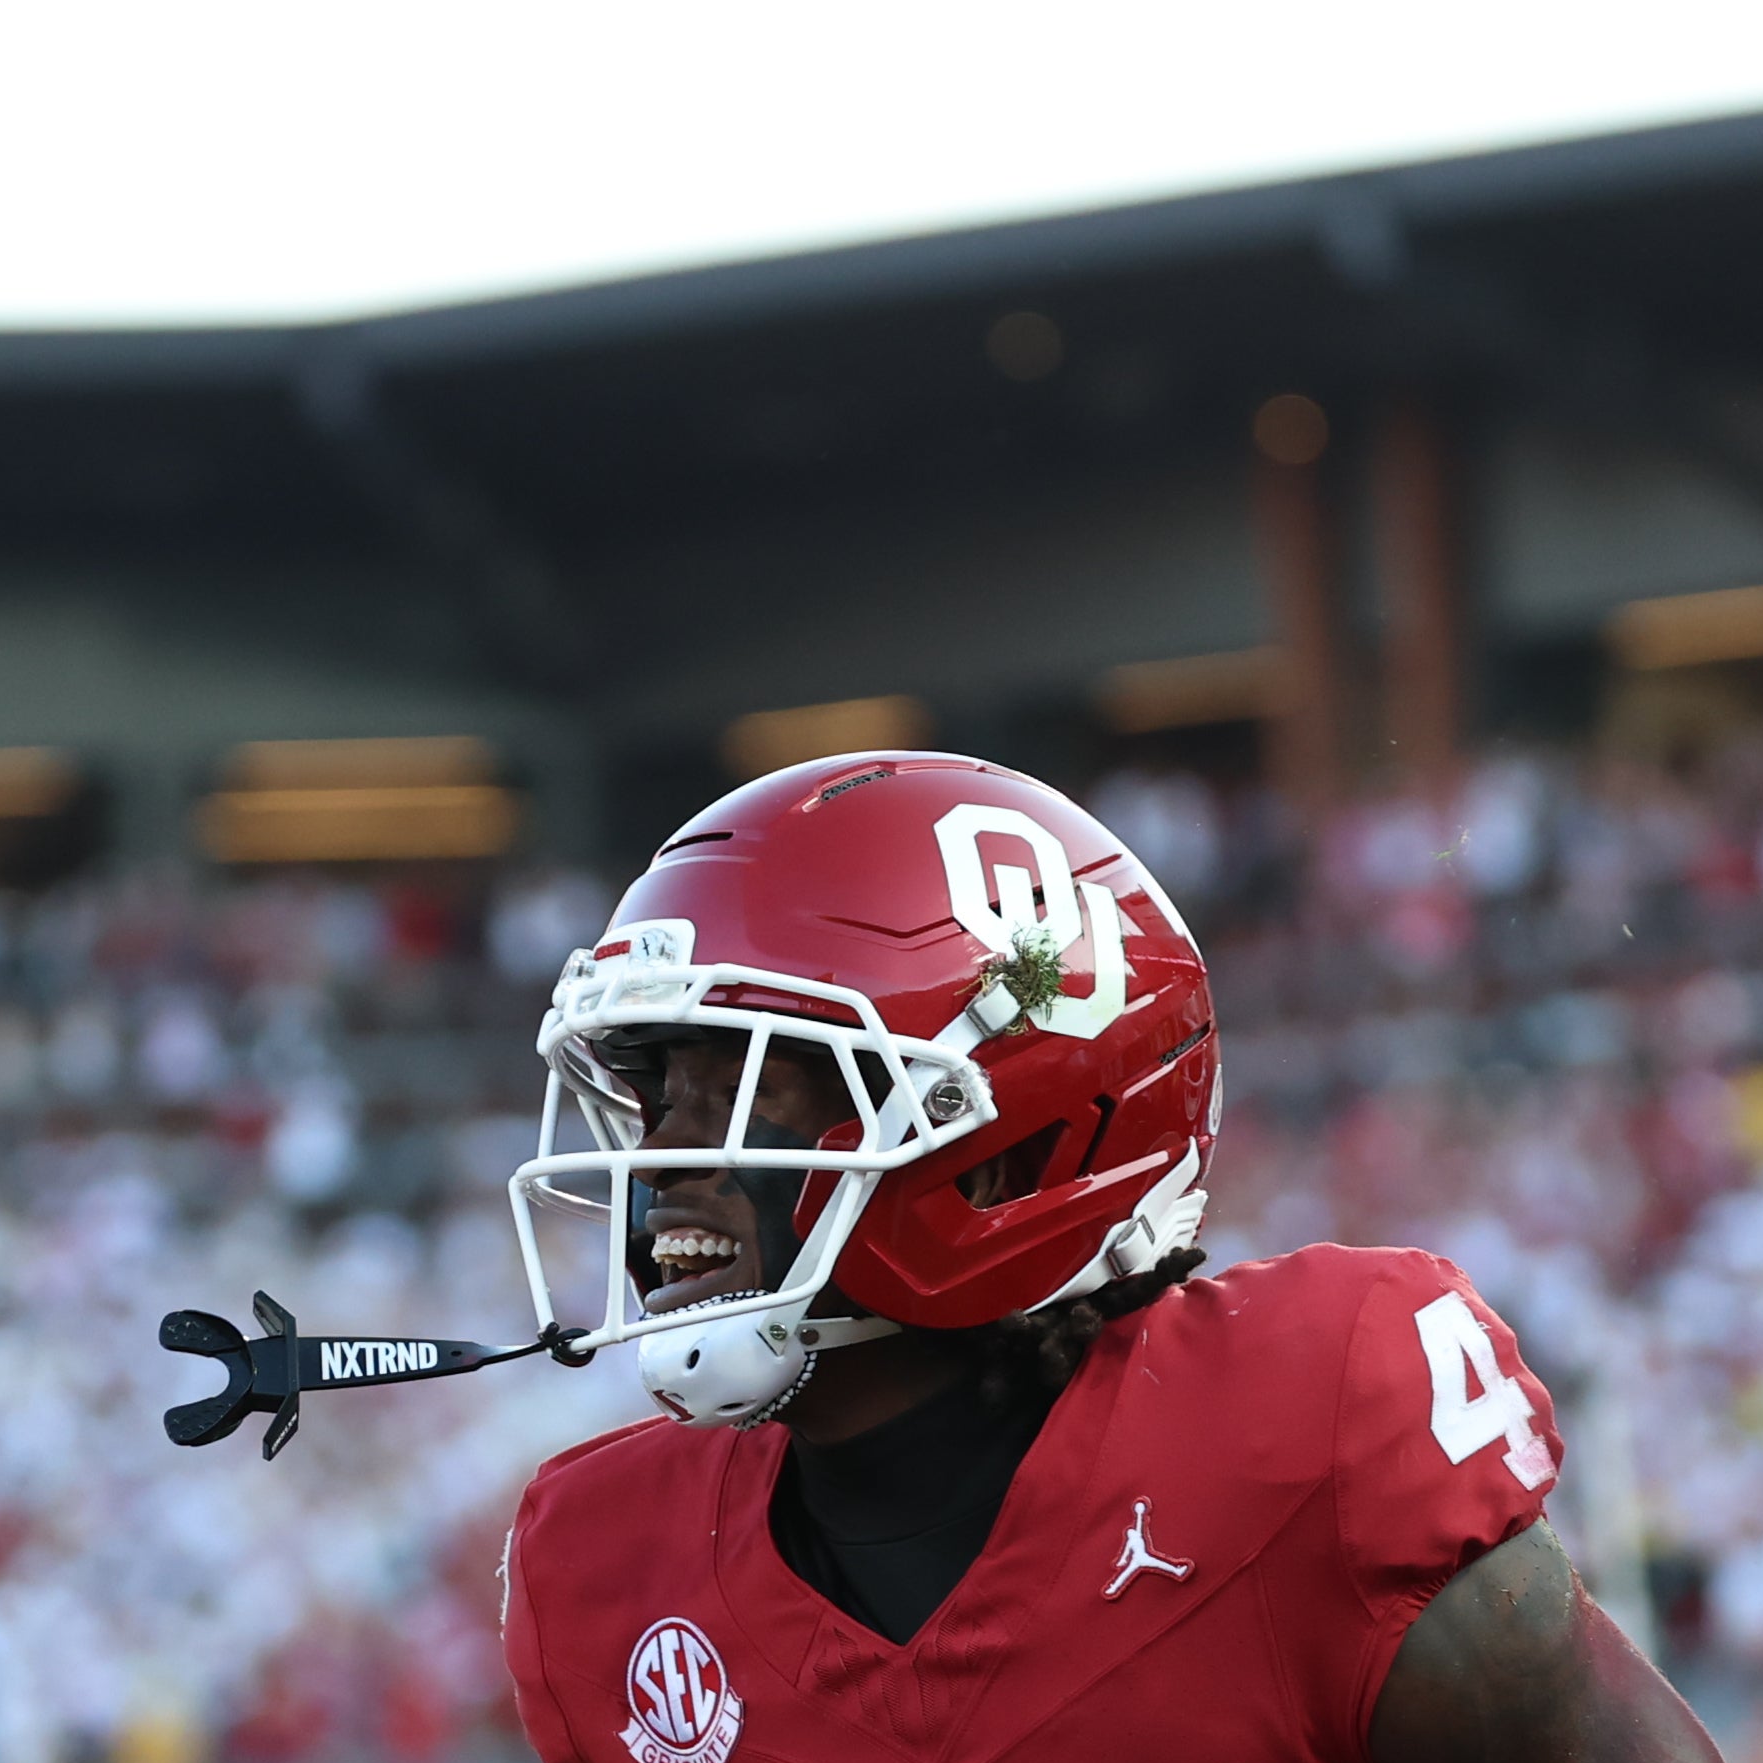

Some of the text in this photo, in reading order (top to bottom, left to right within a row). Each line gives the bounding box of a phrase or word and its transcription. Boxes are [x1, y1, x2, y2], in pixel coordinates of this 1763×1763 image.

[320, 1341, 438, 1380] NXTRND
[1413, 1290, 1561, 1491] 4
[634, 1627, 719, 1744] SEC
